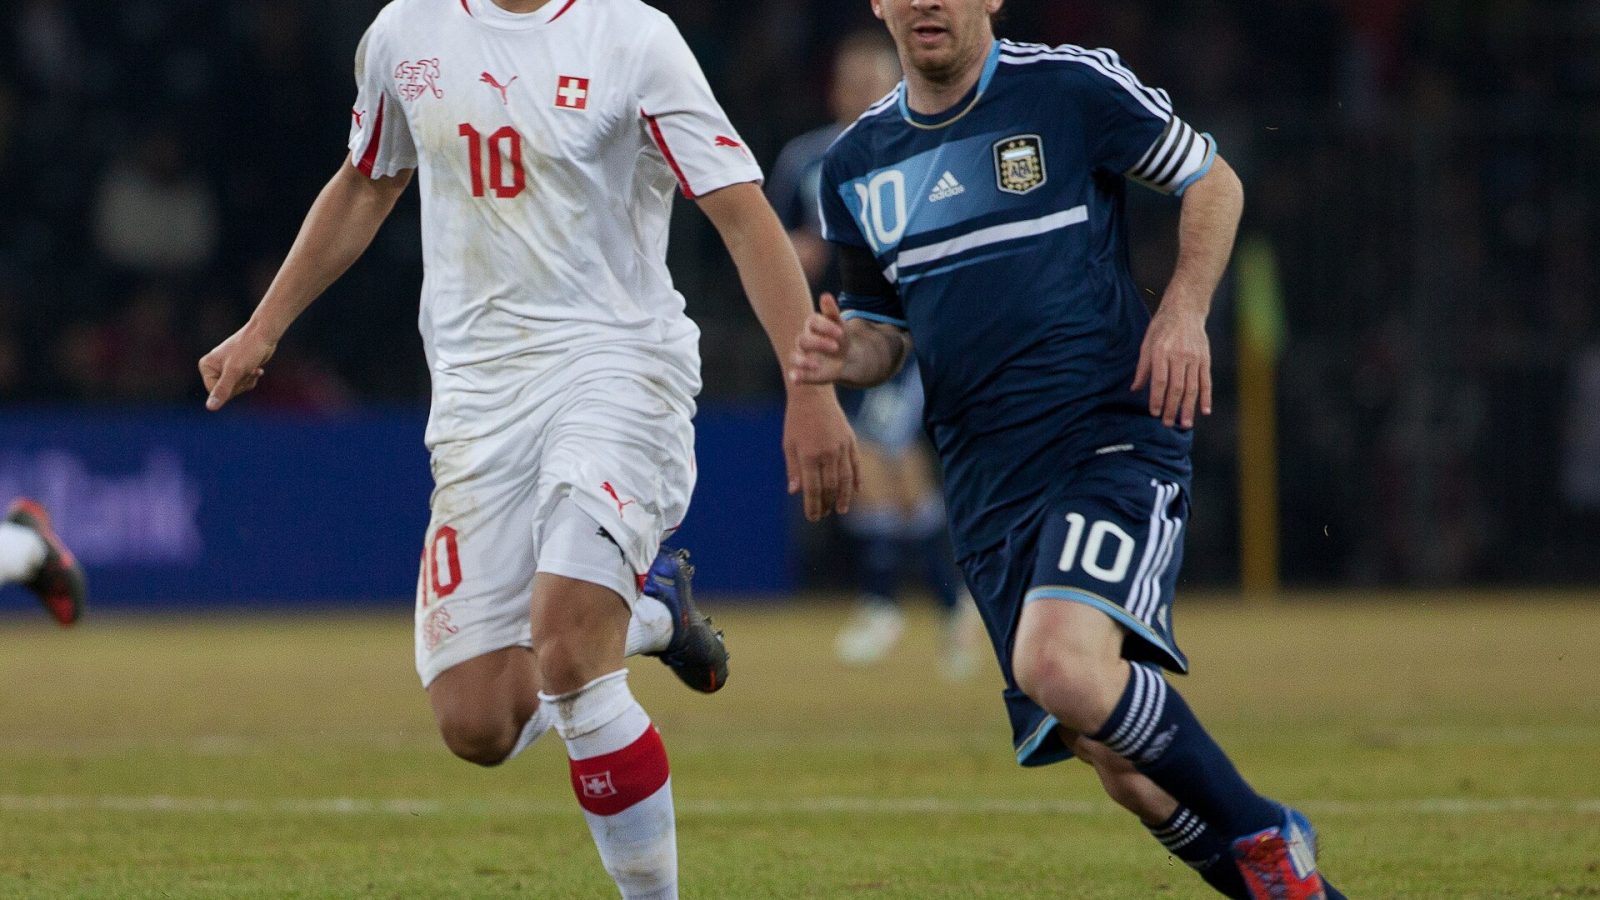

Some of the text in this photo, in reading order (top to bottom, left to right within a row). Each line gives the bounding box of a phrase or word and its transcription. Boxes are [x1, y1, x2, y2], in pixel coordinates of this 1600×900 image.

[458, 122, 526, 198] 10
[928, 184, 966, 202] adidas
[854, 169, 908, 252] 10
[421, 525, 463, 609] 10
[1057, 512, 1136, 583] 10
